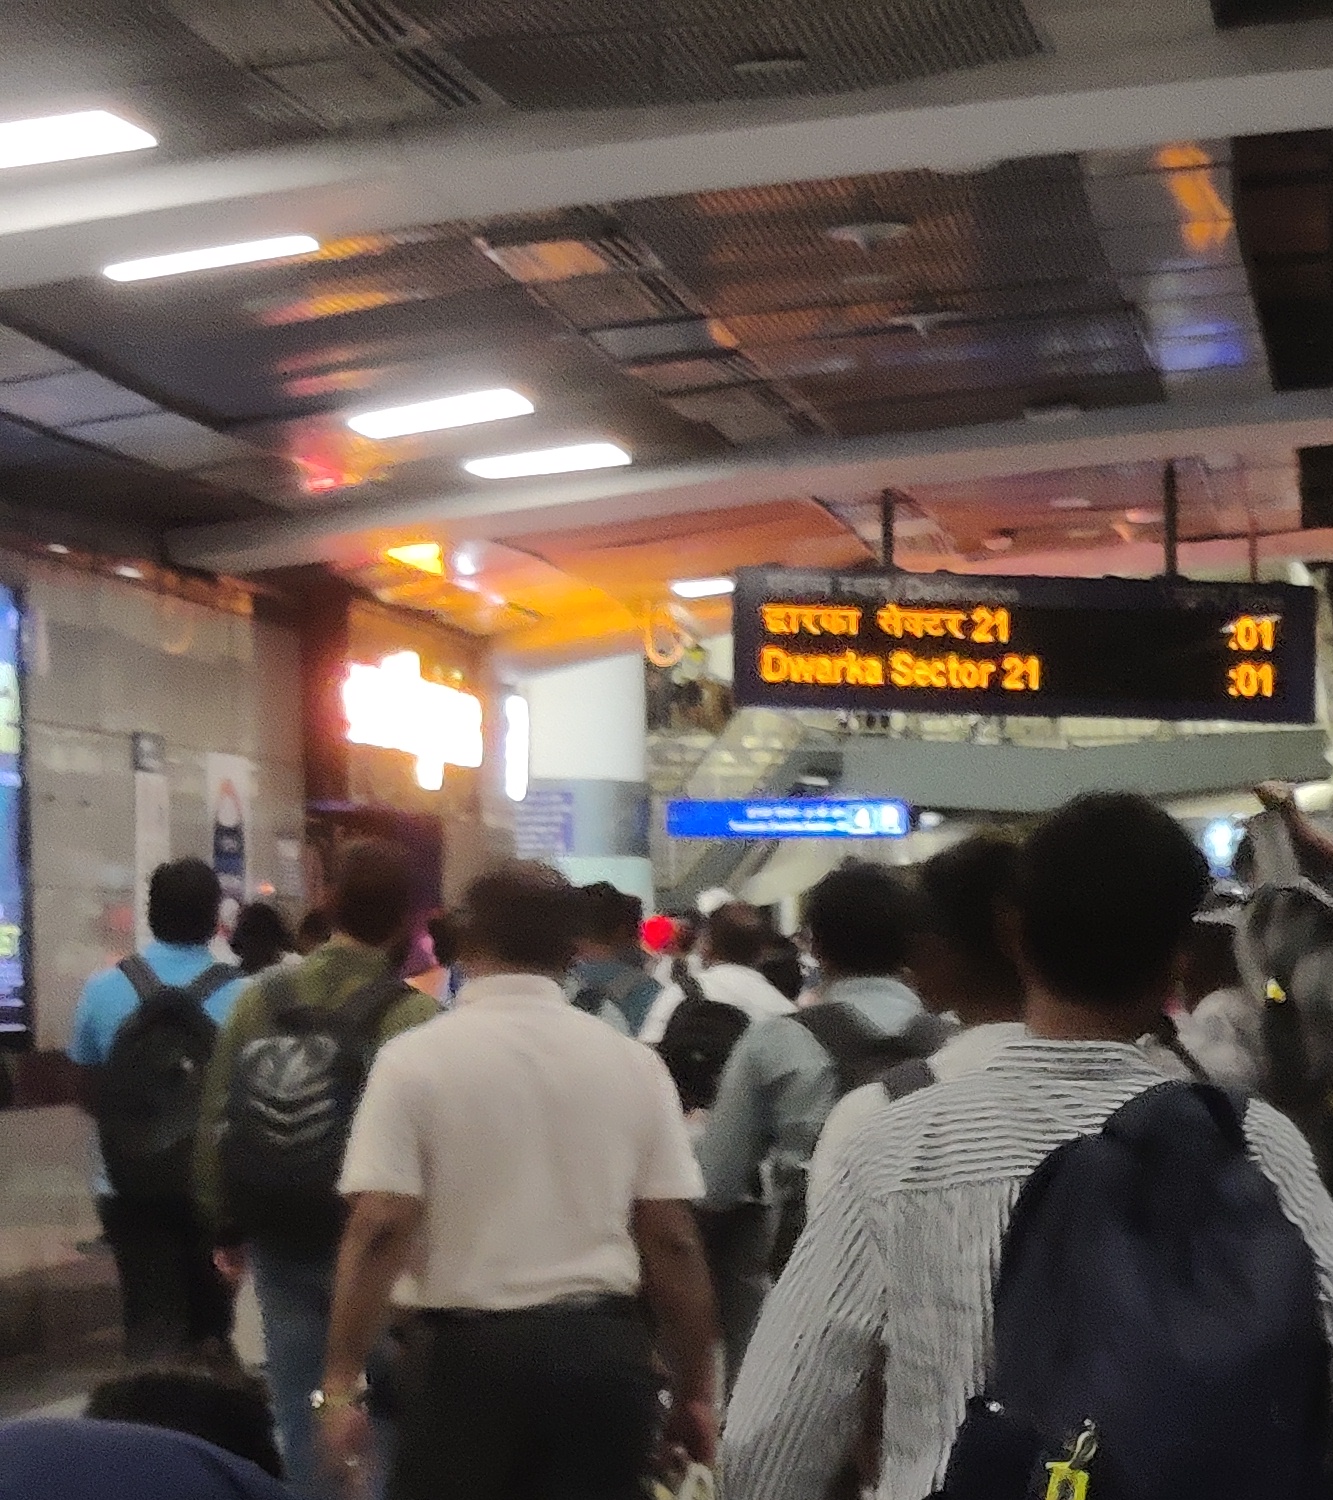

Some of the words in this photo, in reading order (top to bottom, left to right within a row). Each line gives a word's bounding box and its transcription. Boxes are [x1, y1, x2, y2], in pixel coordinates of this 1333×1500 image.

[970, 606, 1010, 644] 21
[760, 644, 885, 685] Dwarka
[889, 648, 996, 689] Sector
[1001, 653, 1040, 691] 21
